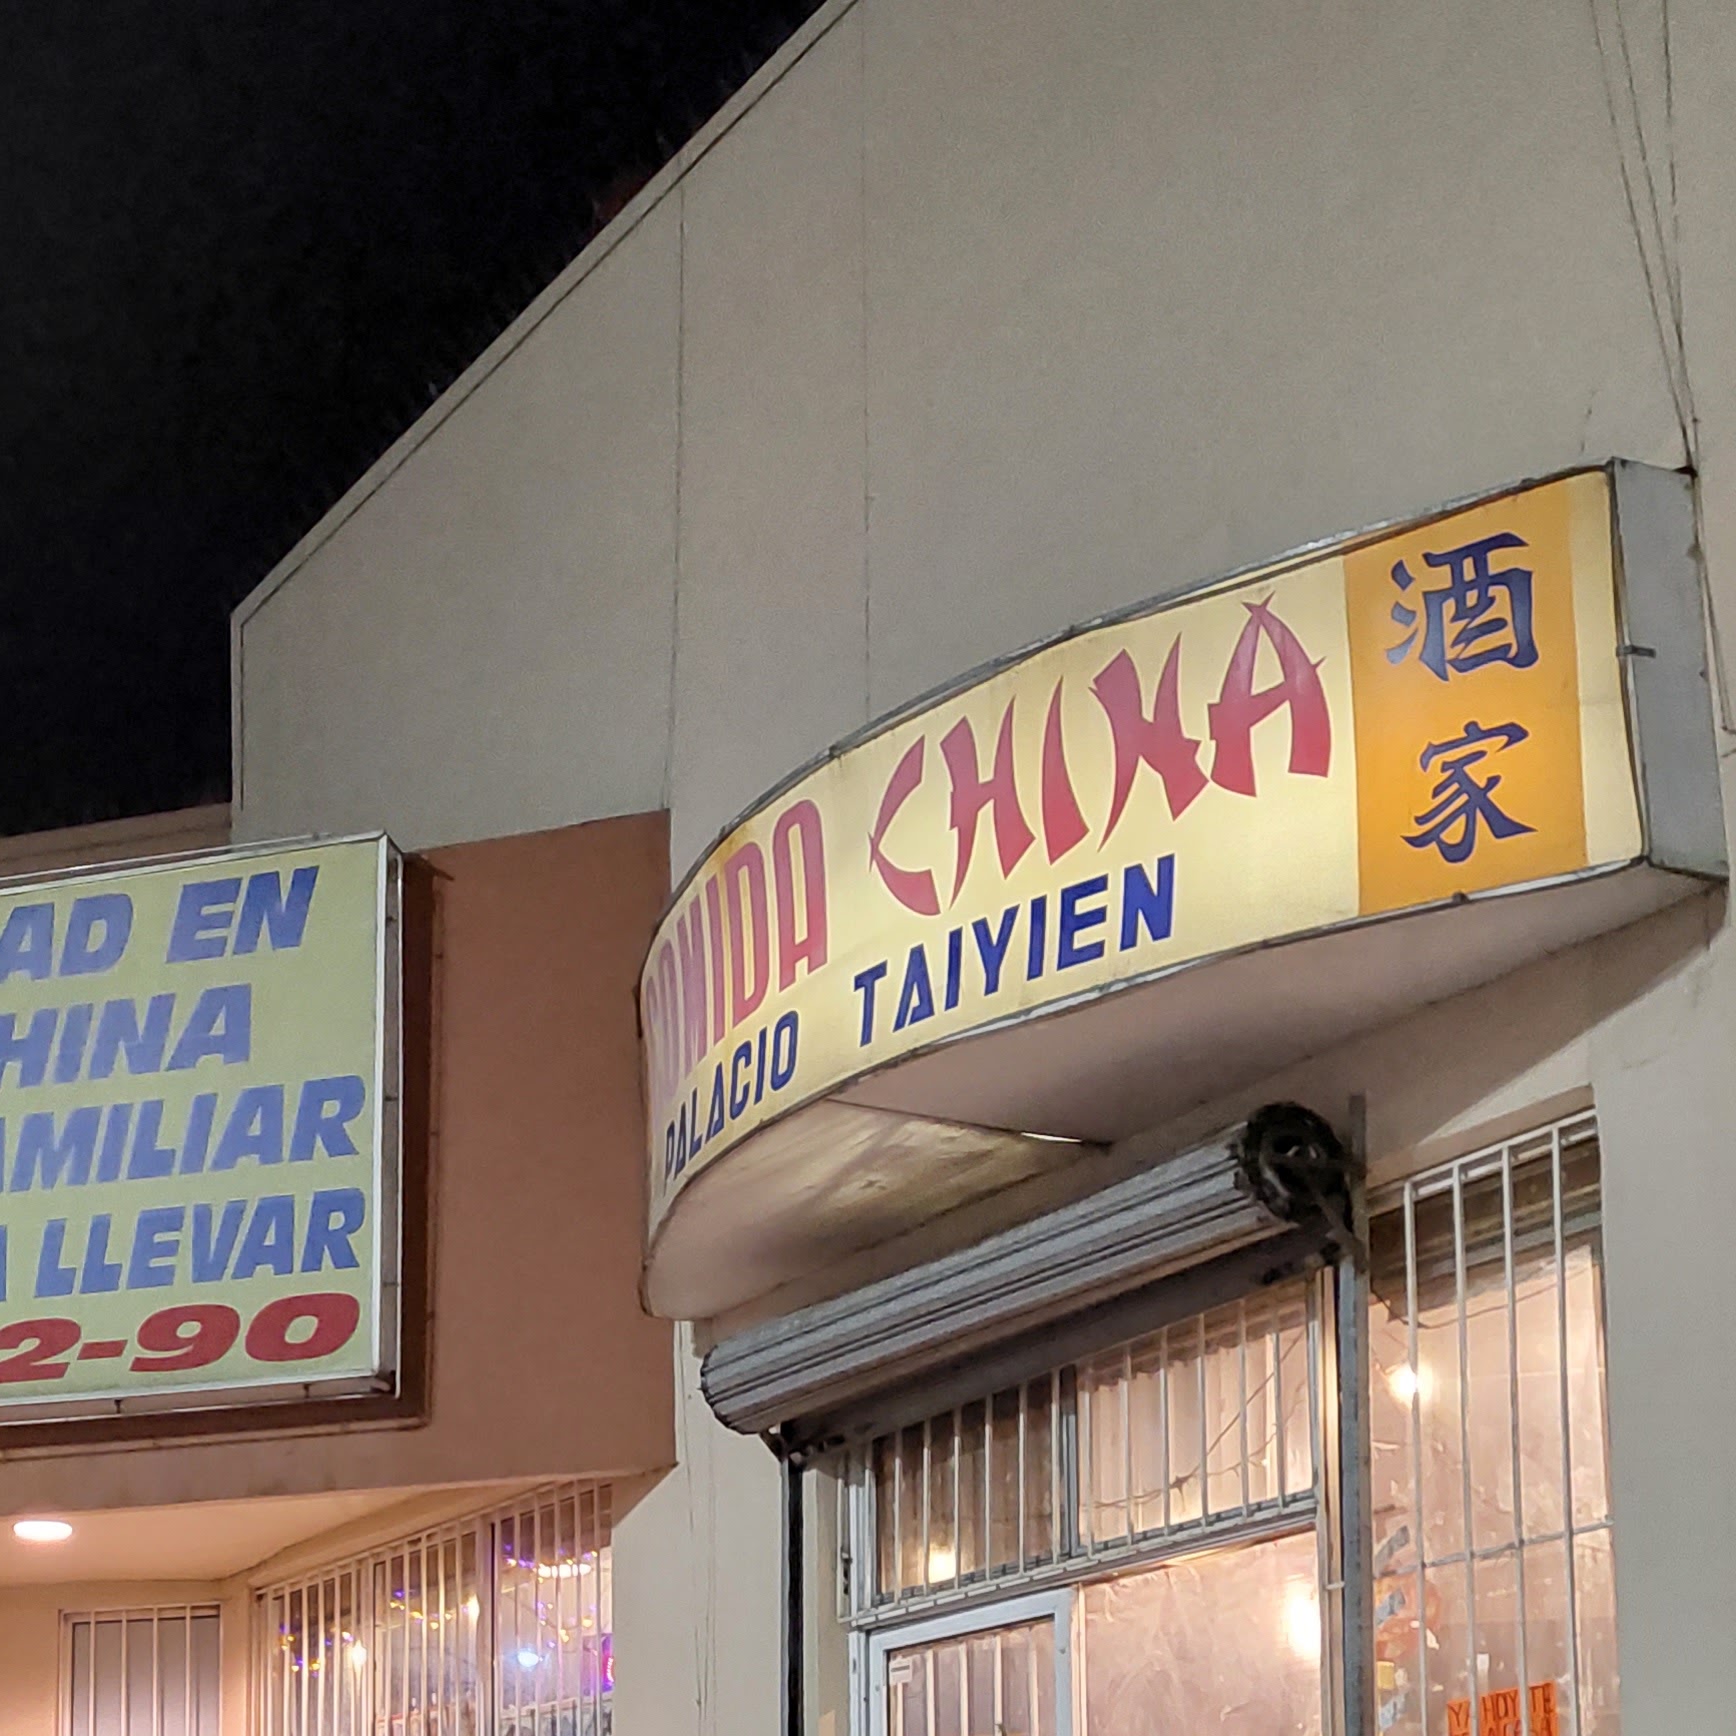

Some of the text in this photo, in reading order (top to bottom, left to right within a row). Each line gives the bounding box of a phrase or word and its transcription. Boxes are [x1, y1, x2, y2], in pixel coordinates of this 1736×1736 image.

[869, 592, 1332, 915] CHINA
[1386, 531, 1537, 864] 酒家
[166, 866, 319, 963] EN
[665, 853, 1175, 1183] PALACIO TAIYIEN
[35, 1188, 365, 1299] LLEVAR
